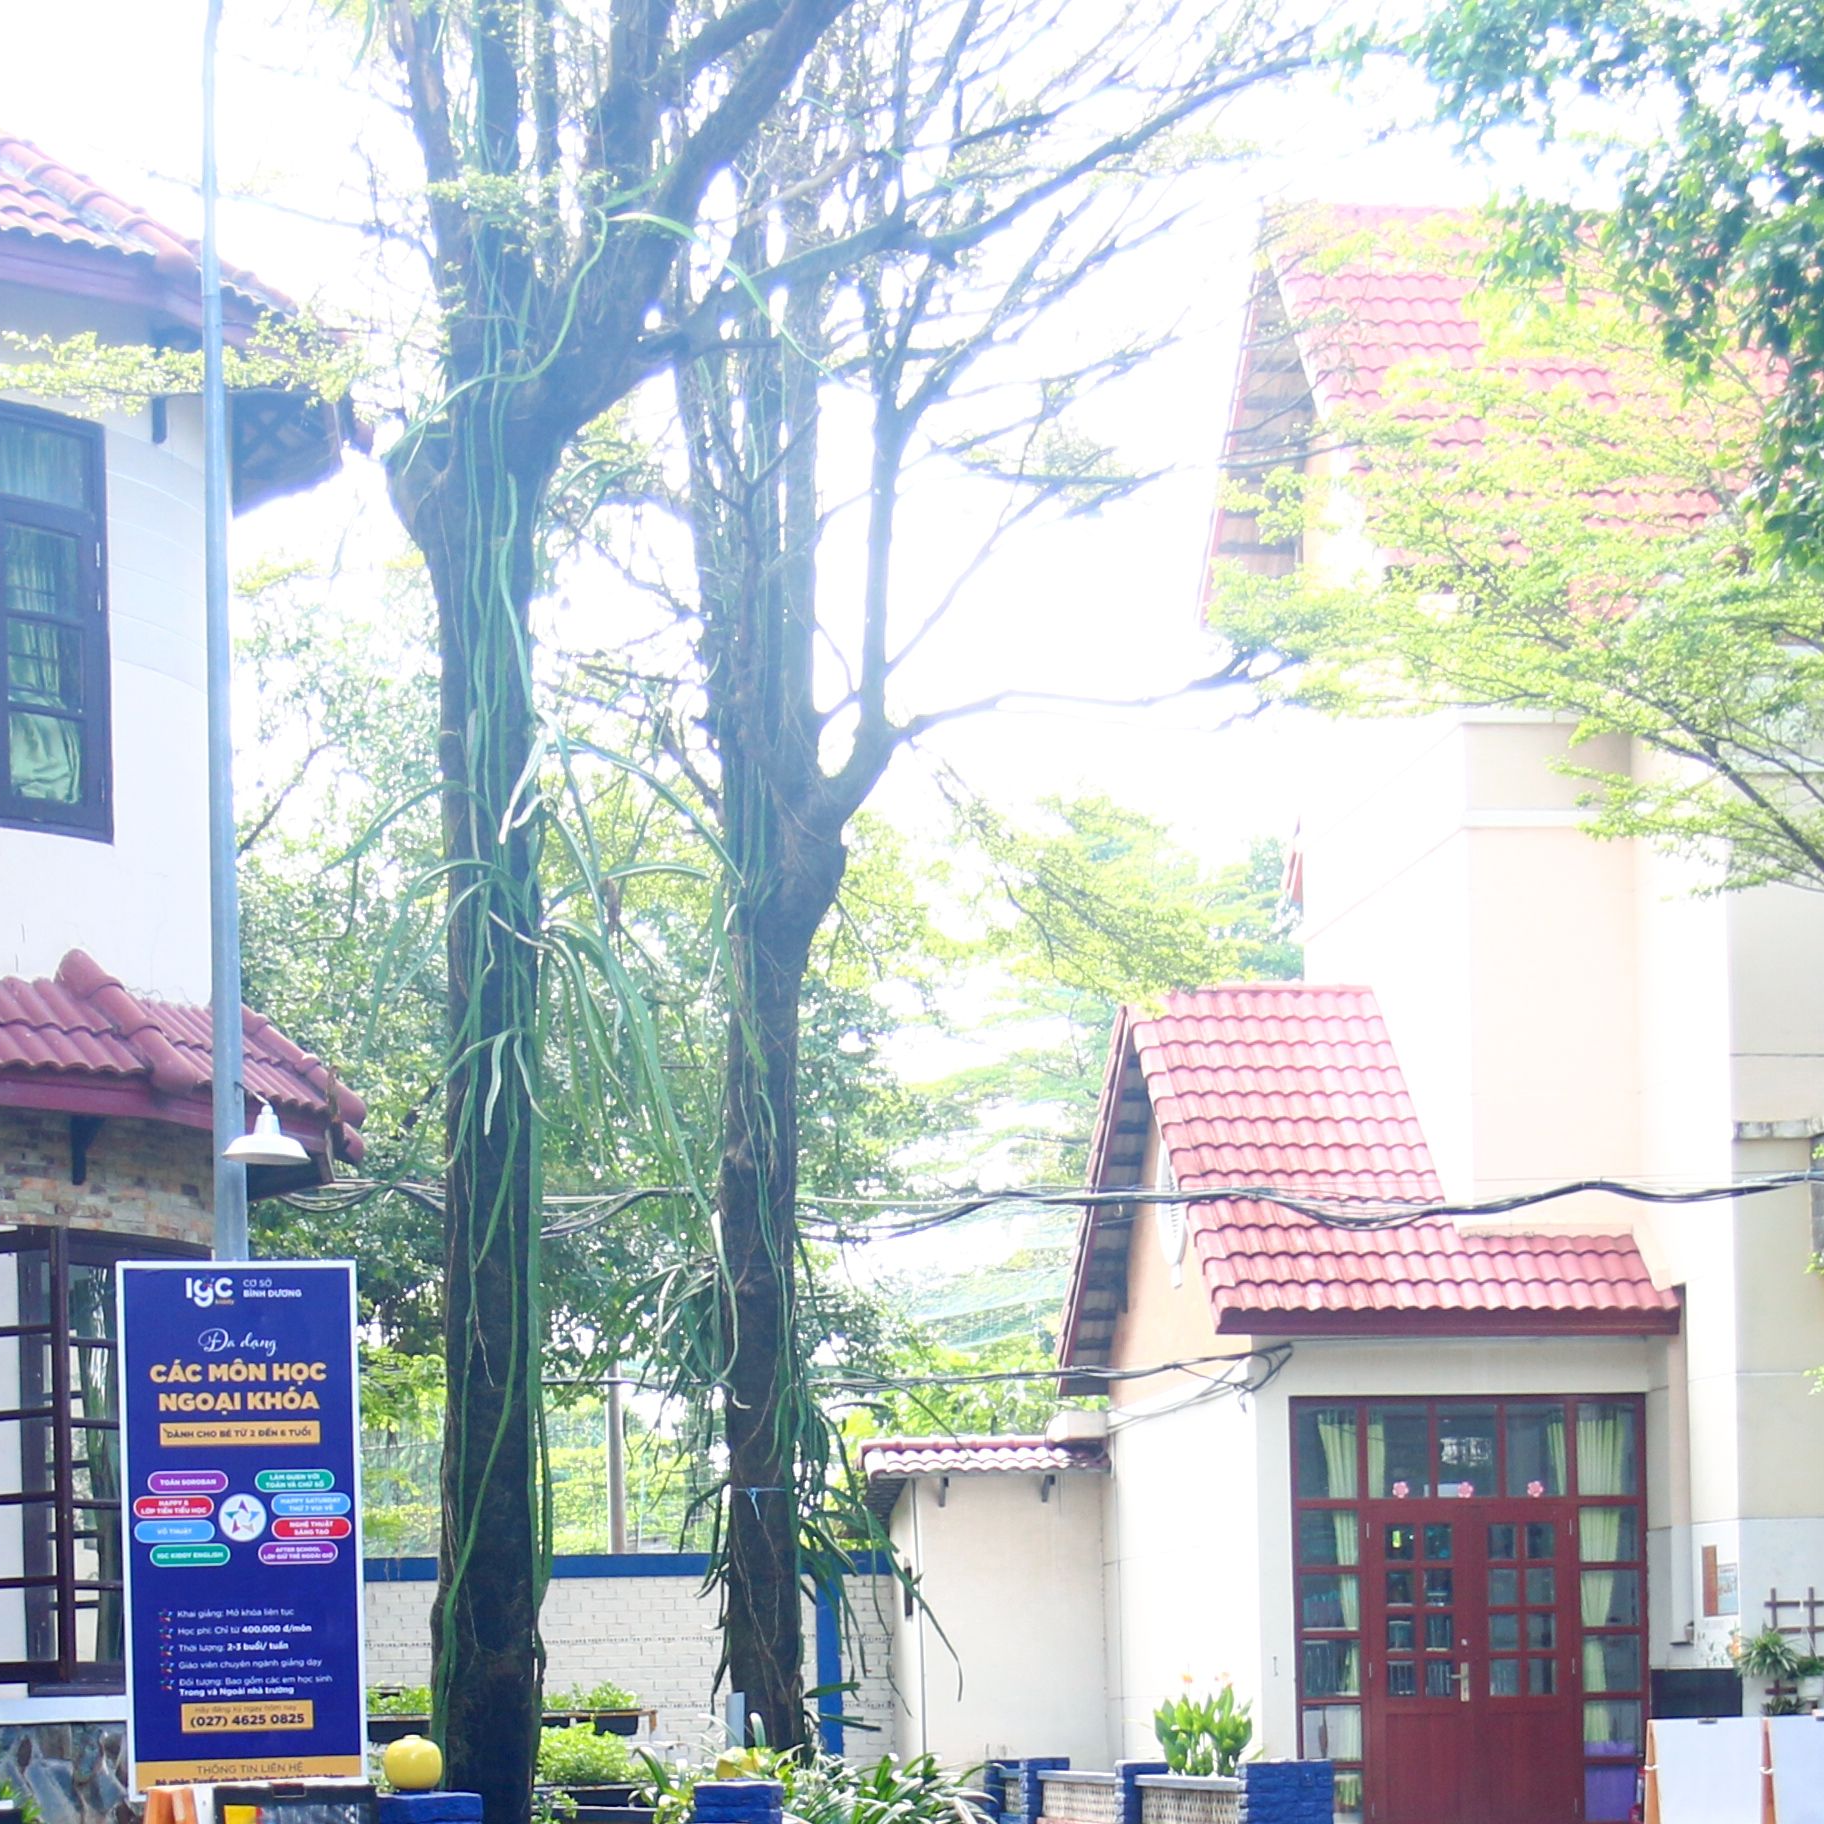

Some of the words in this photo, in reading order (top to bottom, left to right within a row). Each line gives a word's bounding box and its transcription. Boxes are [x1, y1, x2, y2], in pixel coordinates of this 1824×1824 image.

[243, 1288, 266, 1298] BÌNH
[268, 1288, 302, 1298] DƯƠNG
[198, 1328, 235, 1352] Đa
[240, 1332, 276, 1357] dạng
[150, 1359, 202, 1383] CÁC
[208, 1358, 267, 1382] MÔN
[273, 1362, 327, 1385] HỌC
[159, 1392, 241, 1415] NGOẠI
[247, 1387, 320, 1410] KHÓA
[196, 1429, 217, 1438] CHO
[258, 1426, 278, 1437] ĐẾN
[242, 1625, 281, 1634] 400.000
[179, 1688, 205, 1698] Trong
[190, 1716, 228, 1728] (027)
[232, 1714, 266, 1725] 4625
[270, 1713, 305, 1724] 0825
[197, 1763, 237, 1774] THÔNG
[241, 1764, 258, 1773] TIN
[261, 1762, 285, 1773] LIÊN
[288, 1761, 304, 1773] HỆ
